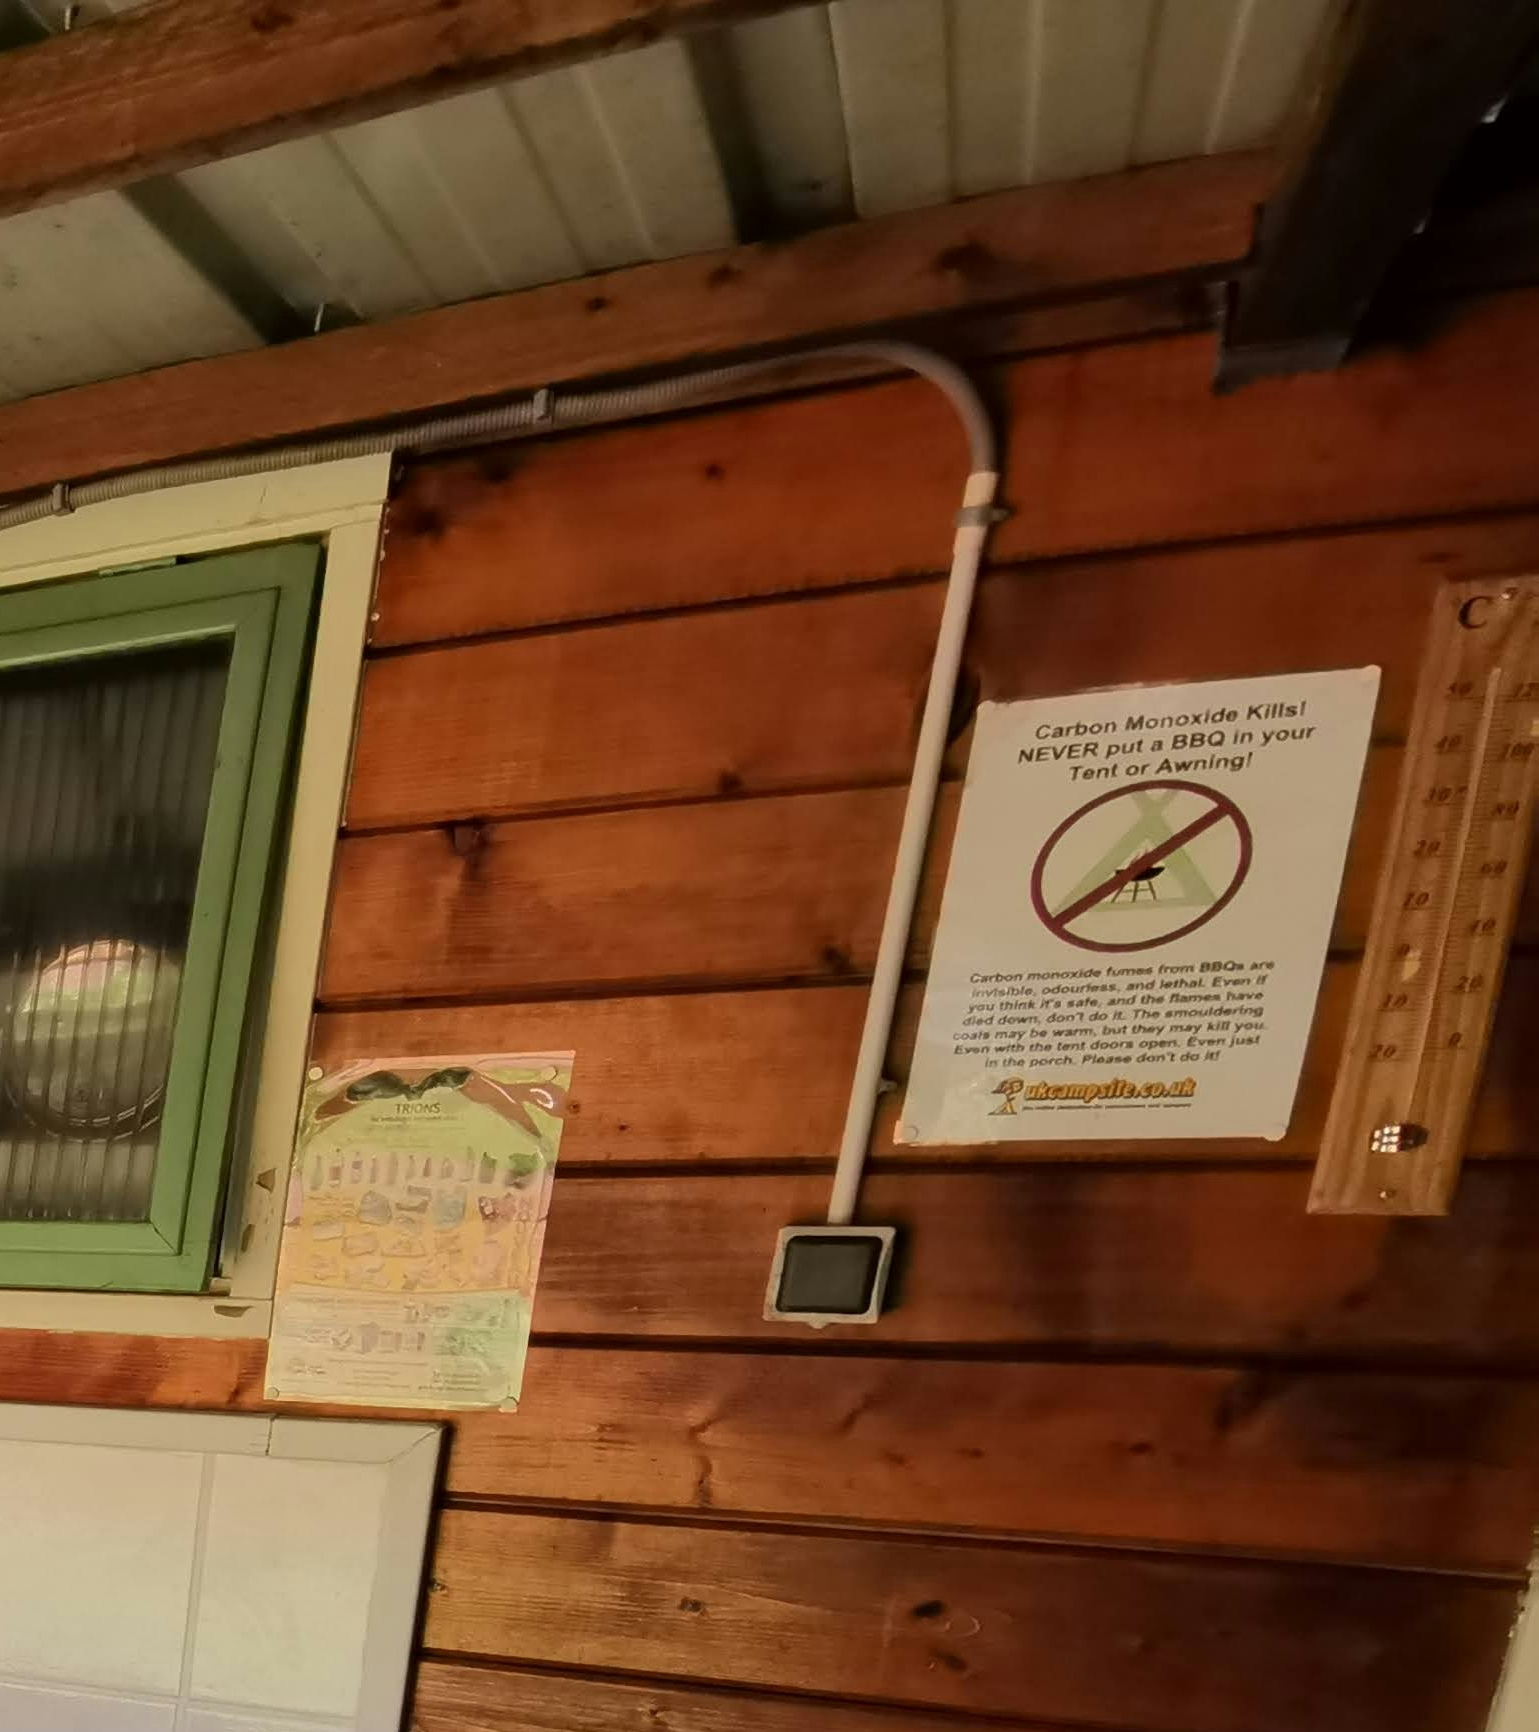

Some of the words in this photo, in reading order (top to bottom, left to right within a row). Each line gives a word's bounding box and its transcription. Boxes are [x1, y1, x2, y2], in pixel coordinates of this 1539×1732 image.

[1457, 596, 1494, 629] C
[1035, 720, 1117, 740] Carbon
[1125, 708, 1238, 731] Monoxide
[1246, 700, 1307, 720] Kills!
[1018, 742, 1099, 764] NEVER
[1105, 739, 1143, 760] put
[1151, 739, 1163, 753] a
[1171, 731, 1225, 750] BBQ
[1233, 728, 1253, 745] in
[1261, 725, 1316, 747] your
[1069, 763, 1118, 781] Tent
[1125, 761, 1150, 777] or
[1155, 752, 1253, 775] Awning!
[970, 972, 1023, 984] Carbon
[1027, 968, 1102, 981] monoxide
[1106, 966, 1153, 977] fumes
[1158, 964, 1195, 975] from
[1199, 960, 1244, 973] BBQs
[1250, 961, 1275, 971] are
[1126, 979, 1156, 991] and
[1212, 976, 1251, 988] Even
[1256, 974, 1269, 985] if
[968, 1003, 995, 1014] you
[999, 1000, 1035, 1011] think
[1106, 995, 1136, 1006] and
[1140, 994, 1165, 1005] the
[1169, 992, 1221, 1004] flames
[1226, 990, 1264, 1001] have
[962, 1015, 995, 1026] died
[997, 1014, 1041, 1026] down,
[1088, 1012, 1109, 1022] do
[1133, 1009, 1160, 1019] The
[1164, 1005, 1264, 1018] smouldering
[953, 1030, 990, 1041] coals
[994, 1031, 1026, 1042] may
[1029, 1027, 1047, 1038] be
[1052, 1027, 1097, 1038] warm,
[1102, 1025, 1128, 1036] but
[1131, 1024, 1164, 1036] they
[1169, 1024, 1202, 1035] may
[1206, 1021, 1231, 1031] kill
[953, 1045, 990, 1056] Even
[994, 1042, 1025, 1052] with
[1029, 1041, 1052, 1052] the
[1057, 1041, 1086, 1051] tent
[1090, 1039, 1134, 1050] doors
[1138, 1039, 1181, 1050] open.
[1186, 1036, 1226, 1047] Even
[1229, 1035, 1261, 1048] just
[985, 1058, 999, 1068] in
[1002, 1056, 1025, 1068] the
[1081, 1053, 1132, 1065] Please
[1136, 1051, 1175, 1063] don't
[1179, 1051, 1200, 1062] do
[1203, 1051, 1221, 1061] it!
[1024, 1076, 1197, 1103] ukcampsite.co.uk
[394, 1102, 441, 1115] TRIONS
